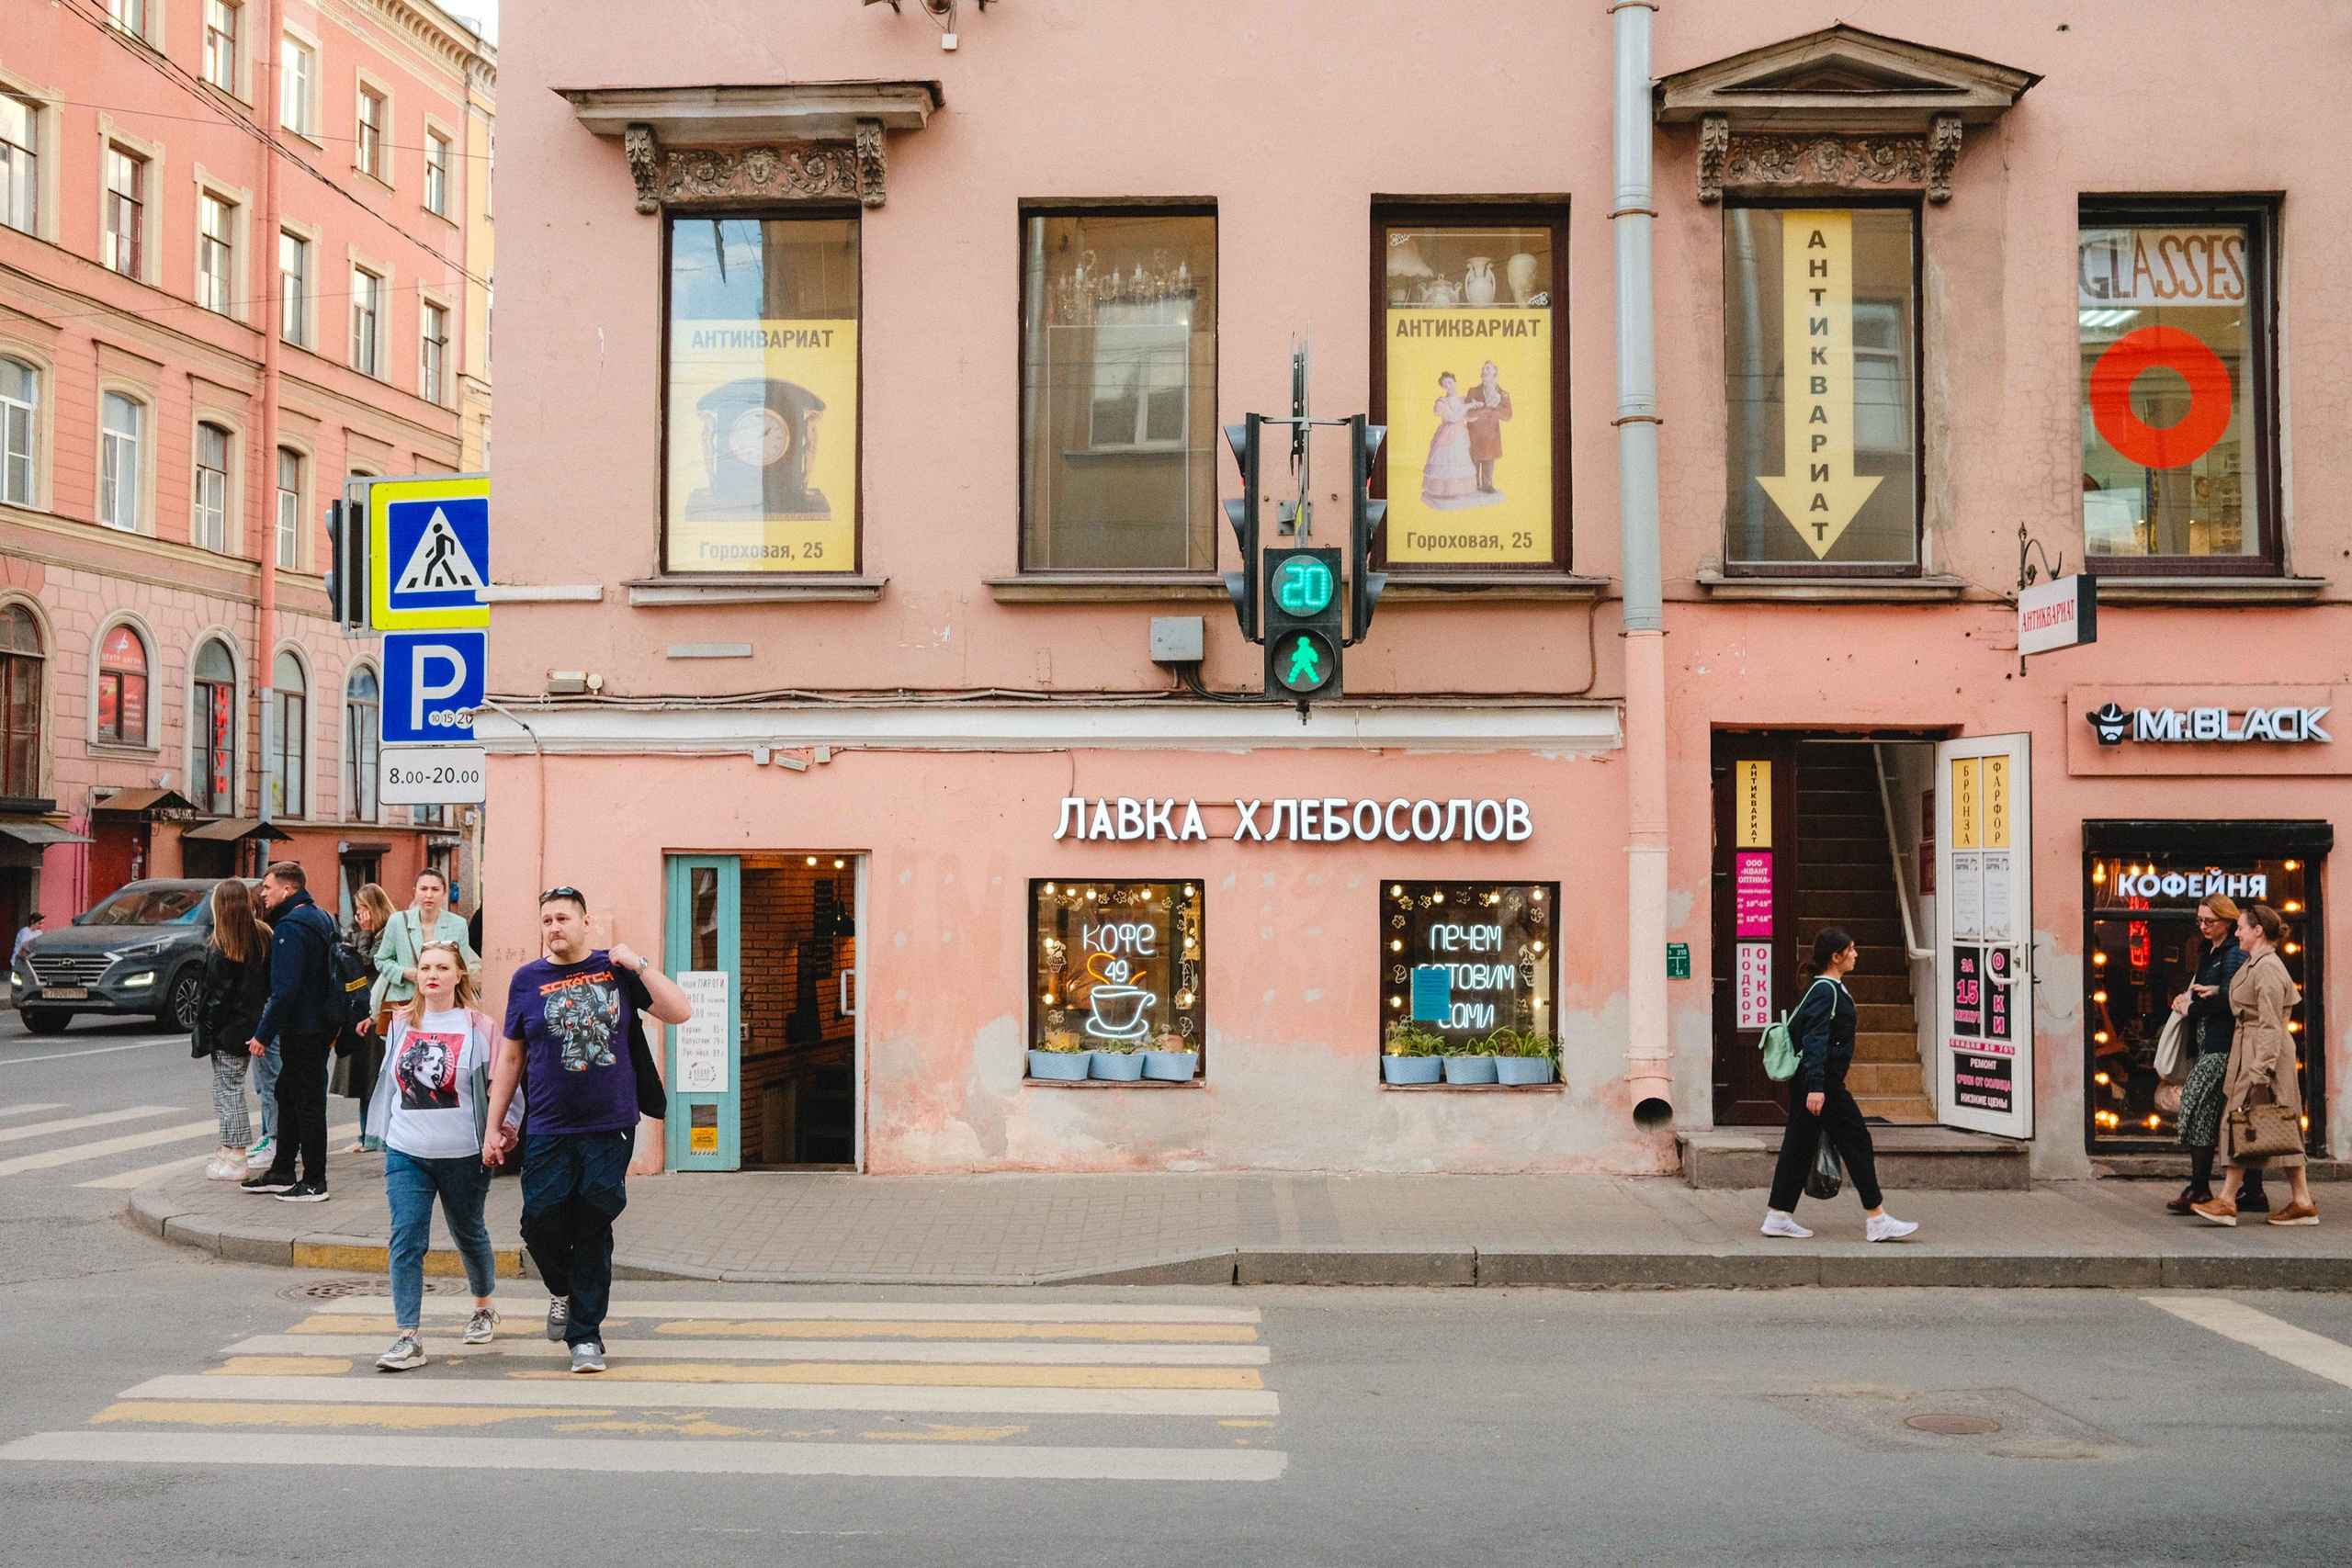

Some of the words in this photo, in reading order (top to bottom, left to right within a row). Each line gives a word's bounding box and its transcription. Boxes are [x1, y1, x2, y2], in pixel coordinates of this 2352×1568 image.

[2078, 231, 2245, 299] GLASSES
[691, 329, 834, 349] АНТИКВАРИАТ
[1396, 318, 1542, 338] АНТИКВАРИАТ
[1807, 230, 1829, 542] АНТИКВАРИАТ
[698, 541, 796, 561] Гороховая,
[802, 541, 824, 558] 25
[1406, 531, 1505, 551] Гороховая,
[1511, 531, 1533, 549] 25
[1282, 564, 1328, 608] 20
[2020, 598, 2075, 634] АНТИКВАРИАТ
[411, 645, 468, 730] P
[431, 714, 441, 723] 10
[444, 713, 454, 724] 15
[216, 685, 230, 795] ЦИГУН
[389, 766, 480, 785] 8.00-20.00
[1749, 762, 1758, 844] АНТИКВАРИАТ
[1962, 764, 1971, 845] БРОНЗА
[1992, 761, 2002, 843] ФАРФОР
[1053, 796, 1207, 842] ЛАВКА
[1233, 797, 1534, 842] ХЛЕБОСОЛОВ
[1746, 859, 1763, 867] ООО
[2118, 869, 2267, 898] КОФЕЙНЯ
[1104, 959, 1128, 983] 49
[1418, 963, 1516, 990] ТОВИМ
[1960, 958, 1974, 974] ЗА
[538, 970, 615, 996] SCRATCH
[697, 977, 725, 988] ПИРОГИ
[1741, 947, 1751, 1024] ПОДБОР
[1756, 947, 1768, 1024] ОЧКОВ
[1956, 978, 1979, 1005] 15
[686, 993, 705, 1003] НОГО
[1953, 1009, 1981, 1024] МИНУТ
[1970, 1057, 1997, 1070] РЕМОНТ
[1974, 1076, 1984, 1088] ОТ
[1960, 1092, 1987, 1106] НИЗКИЕ
[1987, 1096, 2008, 1109] ЦЕНЫ
